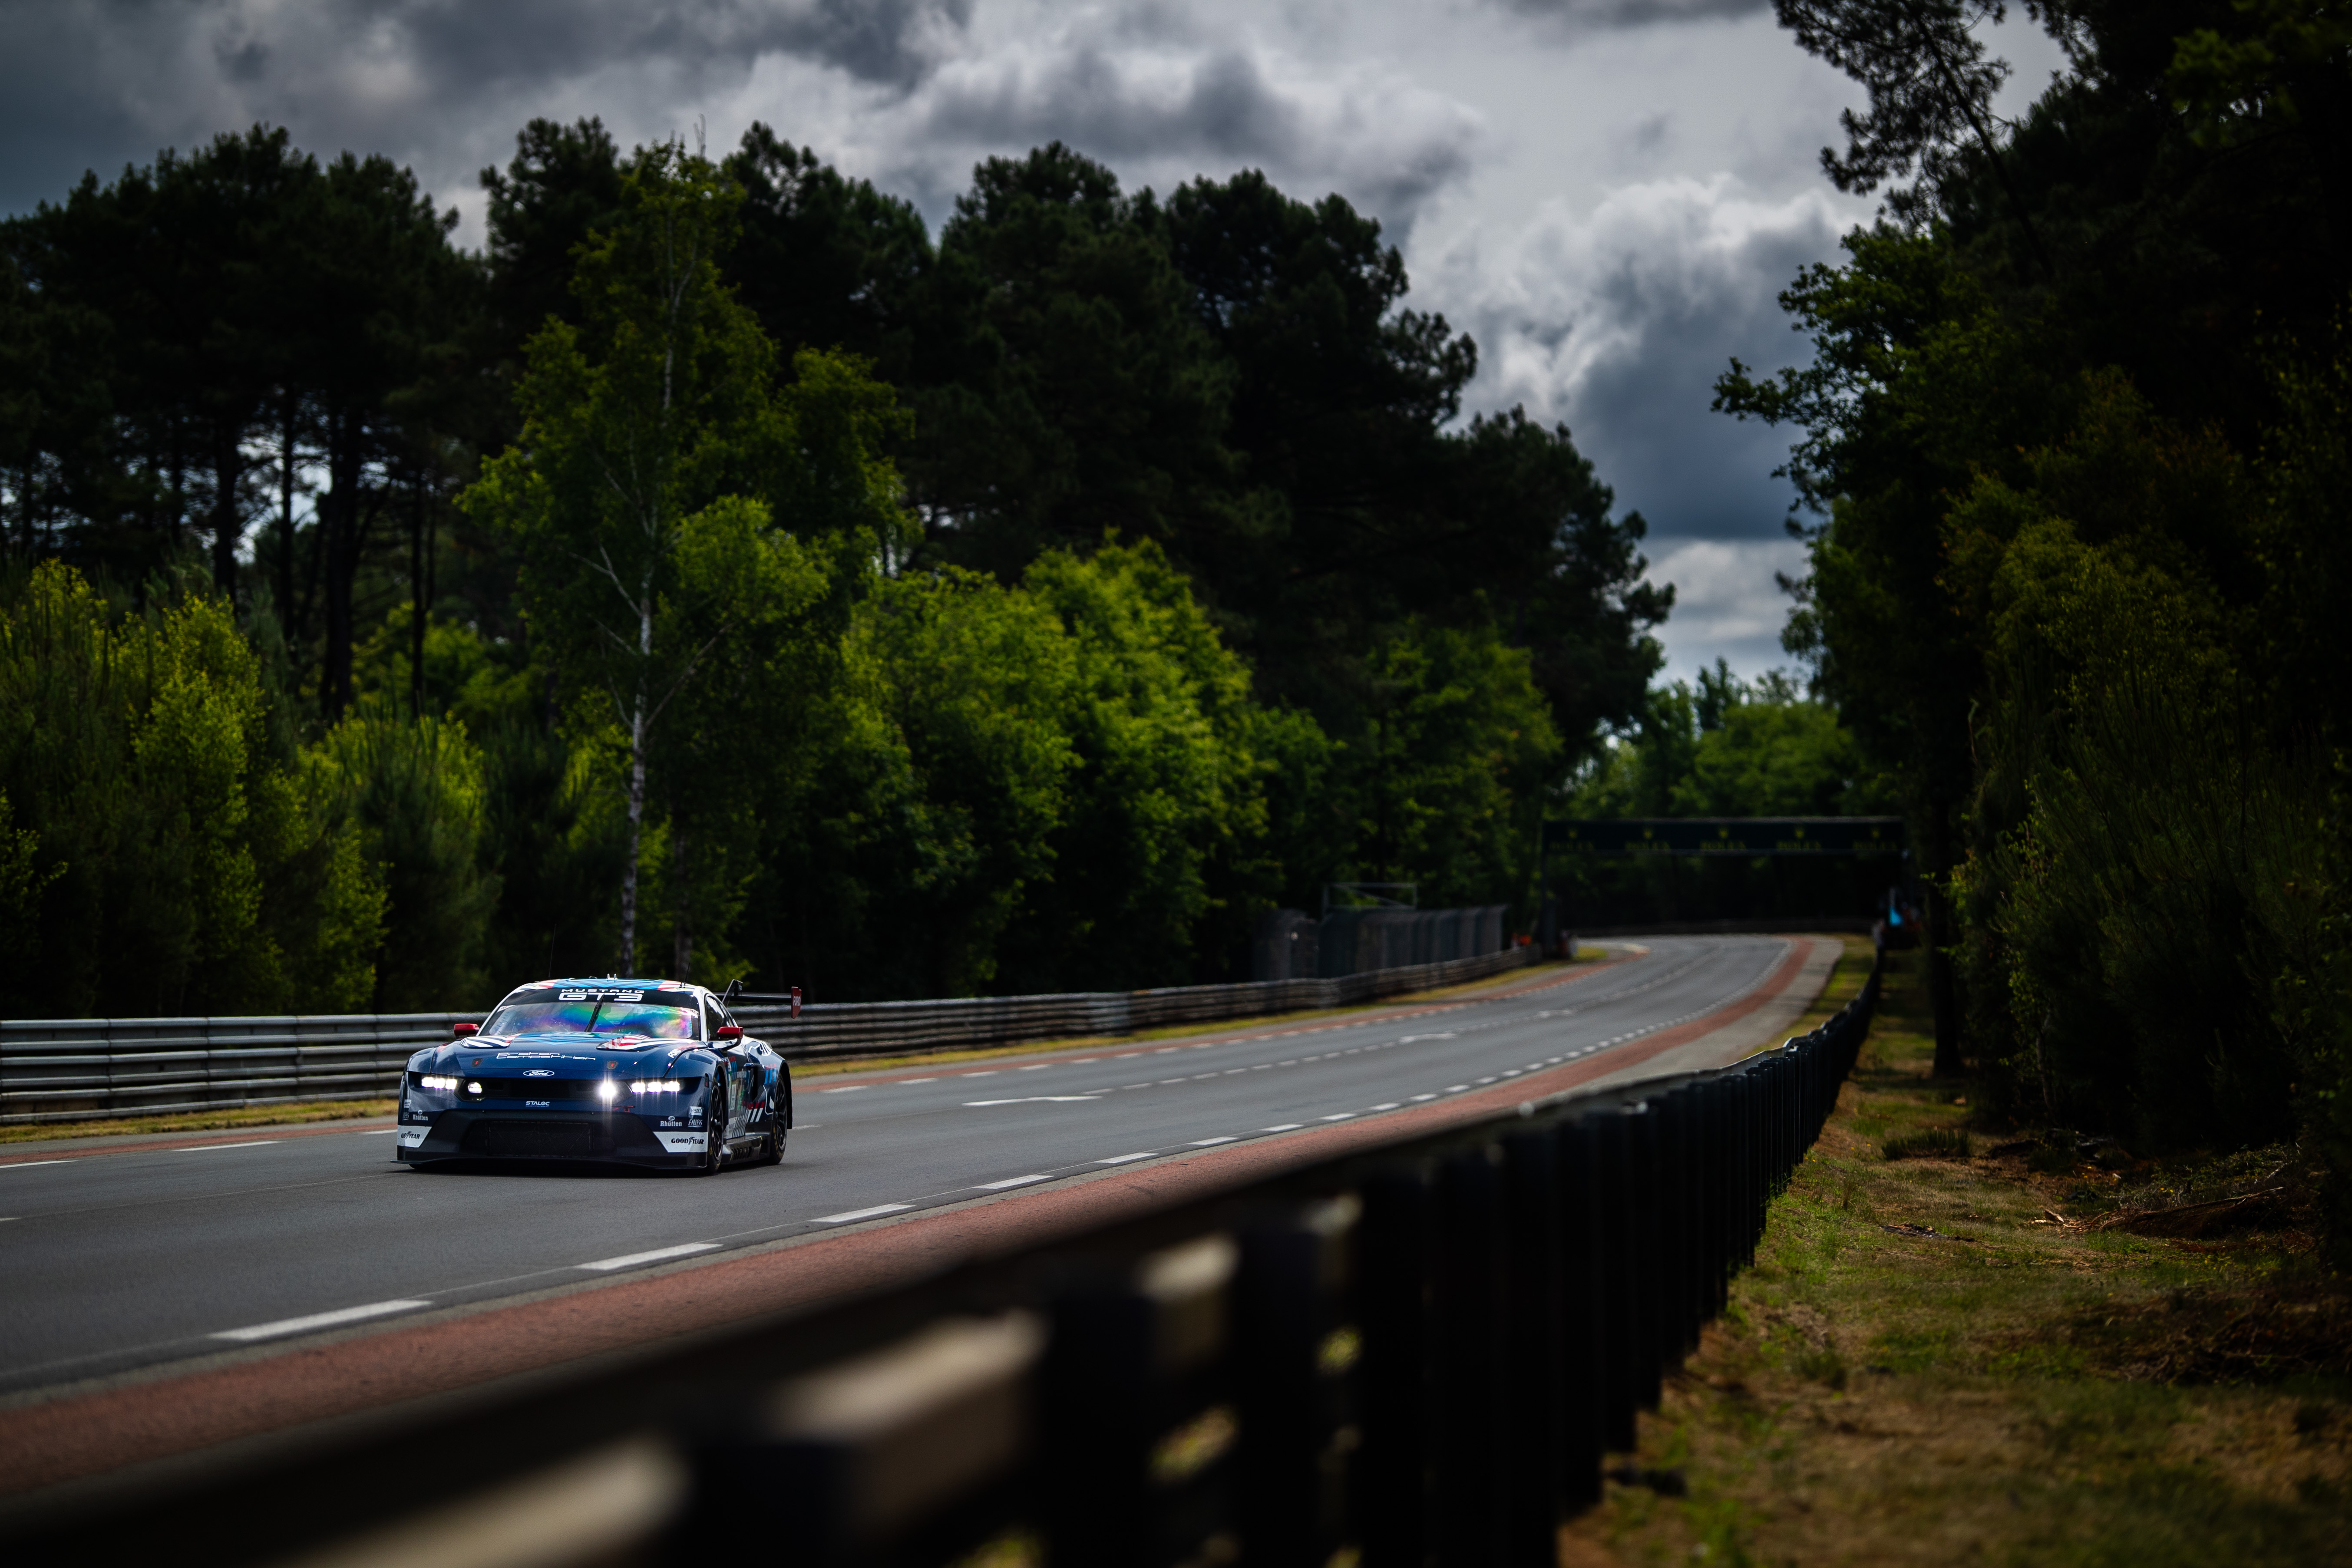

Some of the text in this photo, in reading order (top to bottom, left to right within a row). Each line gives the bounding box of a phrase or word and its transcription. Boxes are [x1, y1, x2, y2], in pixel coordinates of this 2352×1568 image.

[558, 992, 643, 1002] GT3
[793, 996, 801, 1006] FORD
[667, 1048, 682, 1059] FORD
